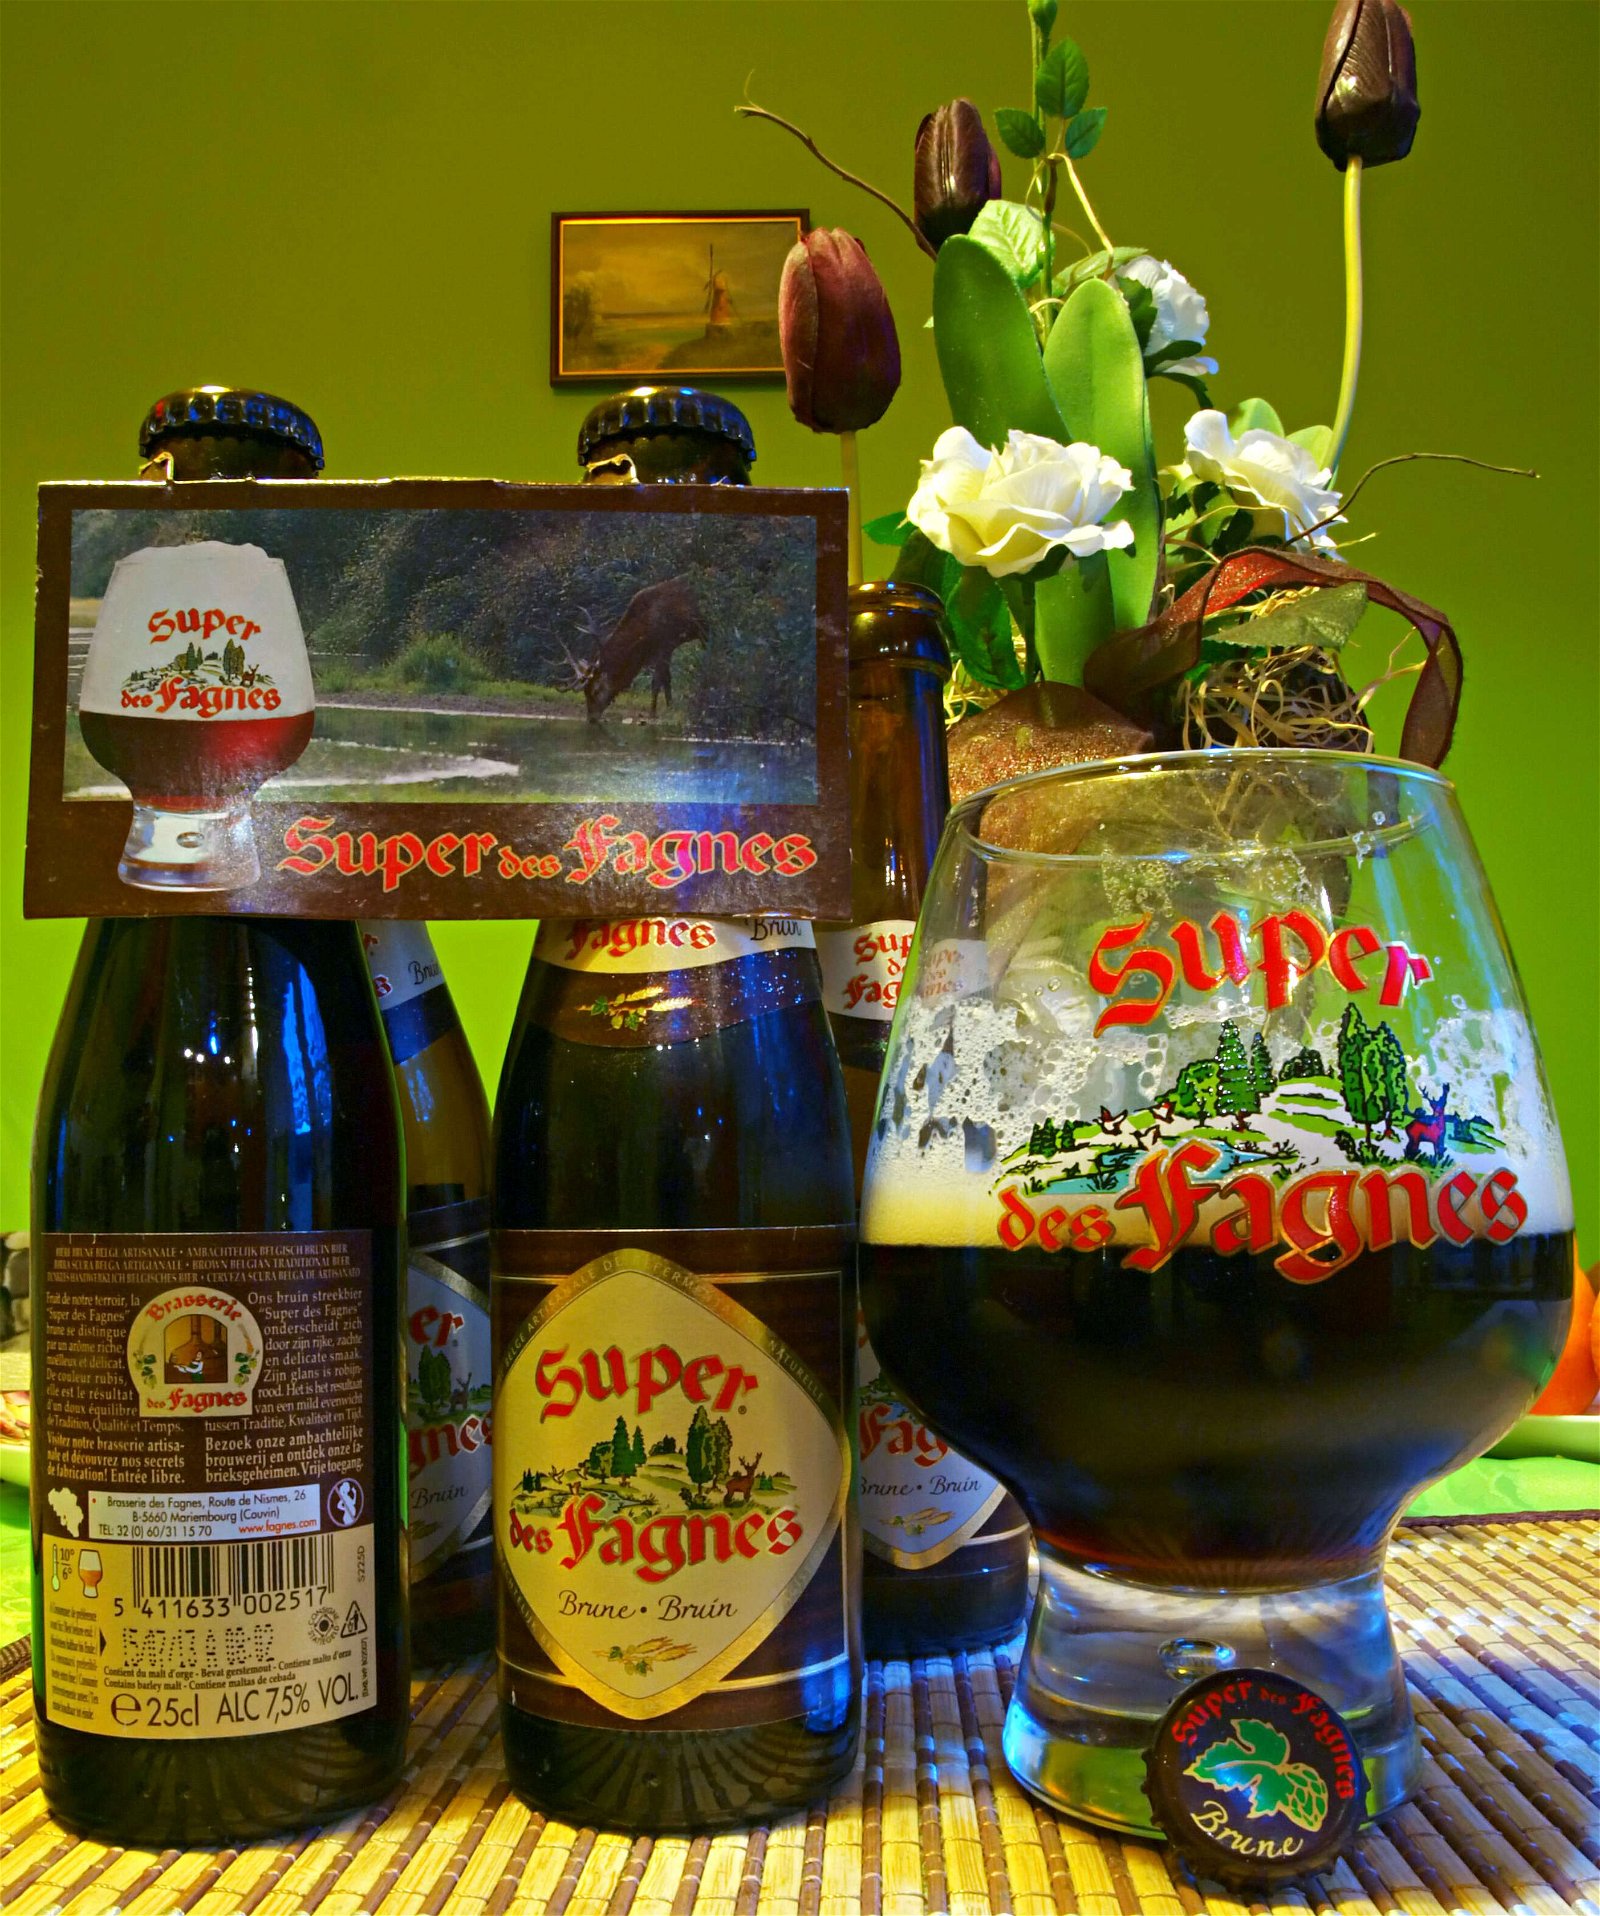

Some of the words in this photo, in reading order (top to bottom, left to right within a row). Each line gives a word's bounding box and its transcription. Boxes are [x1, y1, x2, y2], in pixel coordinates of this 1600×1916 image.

[147, 607, 262, 644] Super
[120, 689, 154, 709] des
[154, 675, 282, 719] Fagnes
[277, 814, 498, 892] Super
[497, 844, 562, 879] des
[562, 813, 818, 890] Fagnes
[853, 932, 913, 966] Sup
[408, 960, 440, 985] Brui
[1087, 905, 1432, 1039] Super
[842, 973, 902, 1009] Fag
[996, 1186, 1116, 1253] des
[1115, 1136, 1529, 1286] Fagnes
[95, 1295, 128, 1308] terroir,
[130, 1294, 140, 1306] la
[248, 1292, 273, 1304] Ons
[277, 1290, 308, 1302] bruin
[312, 1288, 363, 1302] streekbier
[72, 1309, 86, 1321] des
[146, 1294, 242, 1321] Brasserie
[302, 1304, 321, 1318] des
[78, 1324, 126, 1342] distingue
[264, 1320, 339, 1336] onderscheidt
[343, 1319, 362, 1330] zich
[98, 1340, 125, 1354] riche,
[265, 1338, 290, 1350] door
[292, 1337, 310, 1354] zijn
[336, 1332, 362, 1346] zachte
[265, 1356, 279, 1366] en
[283, 1352, 326, 1366] delicate
[58, 1370, 91, 1383] couleur
[95, 1370, 128, 1386] rubis,
[263, 1369, 286, 1384] Zijn
[290, 1368, 320, 1383] glans
[323, 1366, 331, 1377] is
[535, 1343, 759, 1424] Super
[76, 1386, 84, 1399] le
[89, 1386, 134, 1400] résultat
[258, 1384, 282, 1398] rood.
[286, 1384, 304, 1396] Het
[306, 1383, 314, 1394] is
[315, 1380, 328, 1393] het
[88, 1402, 138, 1419] équilibre
[147, 1398, 166, 1408] des
[168, 1387, 248, 1414] Fagnes
[254, 1403, 274, 1414] van
[276, 1402, 294, 1412] een
[296, 1397, 319, 1411] mild
[320, 1392, 362, 1408] evenwicht
[92, 1416, 128, 1433] Qualité
[130, 1420, 140, 1432] et
[142, 1420, 184, 1436] Temps.
[205, 1420, 240, 1432] tussen
[242, 1416, 286, 1430] Traditie,
[289, 1413, 332, 1427] Kwaliteit
[333, 1412, 344, 1422] en
[72, 1436, 94, 1450] notre
[97, 1436, 144, 1451] brasserie
[147, 1439, 185, 1452] artisa-
[205, 1435, 252, 1451] Bezoek
[256, 1436, 286, 1450] onze
[289, 1426, 364, 1446] ambachtelijke
[859, 1402, 948, 1468] Fag
[71, 1451, 118, 1466] découvrez
[122, 1456, 142, 1468] nos
[144, 1454, 185, 1468] secrets
[205, 1451, 266, 1468] brouwerij
[270, 1452, 284, 1463] en
[287, 1445, 326, 1462] ontdek
[328, 1444, 350, 1457] onze
[352, 1440, 364, 1454] fa-
[56, 1464, 108, 1482] fabrication!
[111, 1468, 148, 1483] Entrée
[152, 1470, 185, 1484] libre.
[205, 1466, 300, 1485] brieksgeheimen.
[301, 1460, 326, 1478] Vrije
[327, 1458, 364, 1475] toegang.
[929, 1475, 981, 1496] Bruin
[107, 1496, 146, 1508] Brasserie
[148, 1496, 165, 1508] des
[168, 1497, 205, 1512] Fagnes,
[208, 1496, 236, 1507] Route
[238, 1494, 251, 1506] de
[254, 1492, 291, 1505] Nismes,
[294, 1490, 306, 1501] 26
[132, 1512, 167, 1523] B-5660
[170, 1509, 238, 1524] Mariembourg
[238, 1518, 318, 1534] www.fagnes.com
[117, 1526, 129, 1537] 32
[131, 1525, 144, 1538] (0)
[146, 1525, 177, 1538] 60/31
[182, 1526, 195, 1537] 15
[199, 1525, 212, 1537] 70
[509, 1507, 553, 1555] des
[556, 1492, 803, 1585] Fagnes
[114, 1598, 124, 1616] 5
[141, 1598, 230, 1619] 411633
[244, 1586, 328, 1616] 002517
[558, 1589, 637, 1618] Brune
[657, 1594, 738, 1622] Bruin
[104, 1666, 134, 1678] Contient
[136, 1667, 147, 1678] du
[149, 1668, 166, 1678] malt
[168, 1668, 194, 1680] d'orge
[201, 1666, 224, 1678] Bevat
[278, 1660, 310, 1670] Contiene
[104, 1678, 136, 1689] Contains
[137, 1680, 162, 1692] barley
[164, 1680, 182, 1690] malt
[188, 1679, 226, 1690] Contiene
[228, 1676, 256, 1688] maltas
[257, 1674, 267, 1684] de
[269, 1672, 296, 1684] cebada
[146, 1692, 200, 1726] 25cl
[216, 1690, 260, 1724] ALC
[266, 1682, 310, 1724] 7,5%
[318, 1672, 358, 1709] VOL.
[1171, 1680, 1254, 1748] Super
[1290, 1691, 1356, 1800] Fagnes
[1190, 1799, 1304, 1859] Brune
